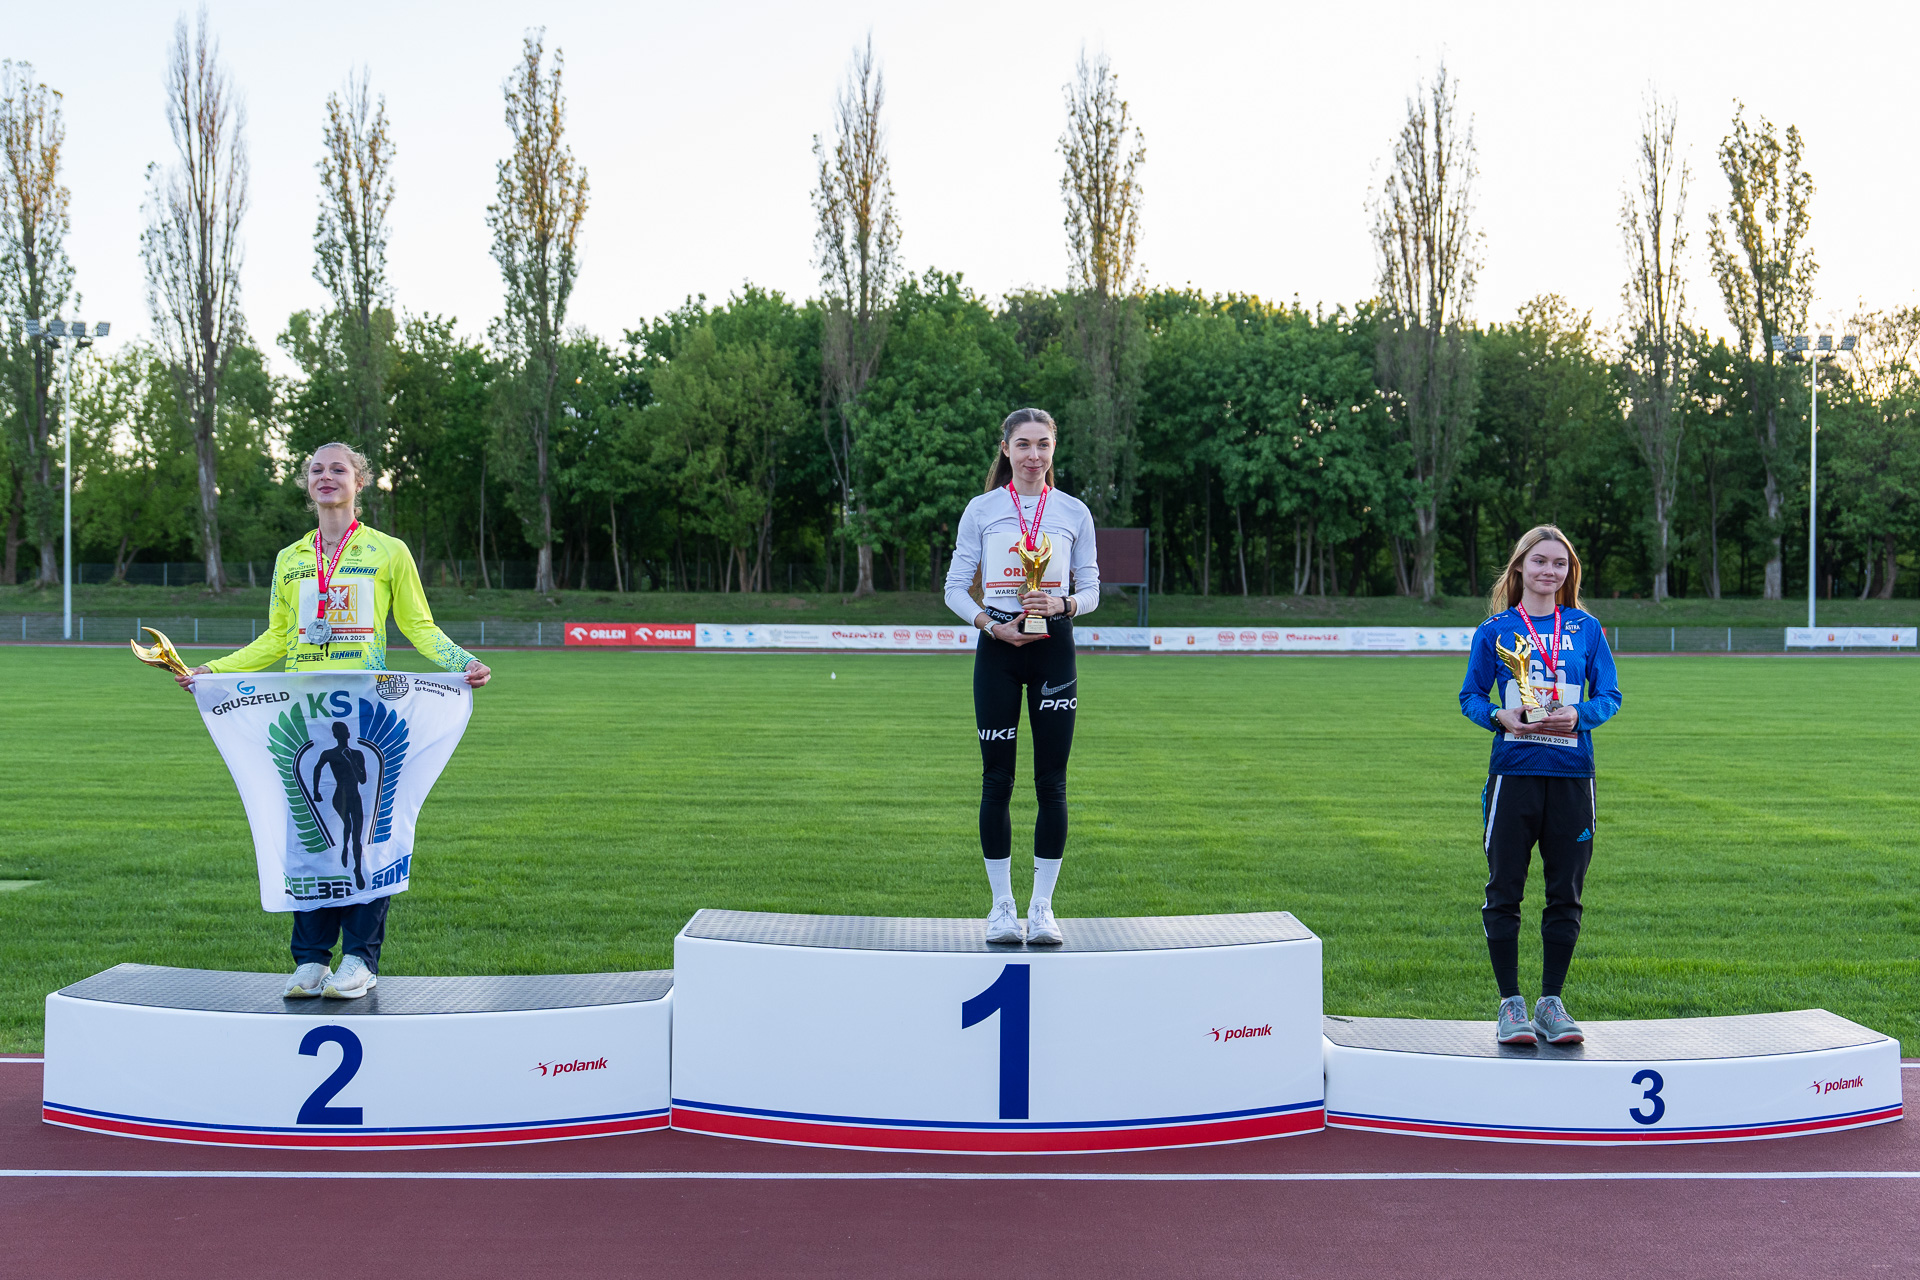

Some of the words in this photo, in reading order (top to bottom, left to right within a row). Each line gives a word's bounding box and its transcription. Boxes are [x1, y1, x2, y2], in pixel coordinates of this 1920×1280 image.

[991, 610, 1013, 621] PRO
[590, 629, 626, 639] ORLEN
[655, 630, 691, 640] ORLEN
[1523, 633, 1574, 651] STRA
[1529, 659, 1567, 685] 65
[413, 678, 461, 695] Zasmakuj
[212, 691, 290, 715] GRUSZFELD
[306, 690, 353, 719] KS
[1039, 697, 1077, 710] PRO
[977, 727, 1016, 741] NIKE
[1514, 734, 1552, 743] WARSZAWA
[371, 854, 412, 891] SON
[961, 963, 1031, 1120] 1
[1224, 1024, 1273, 1042] polanik
[295, 1024, 363, 1125] 2
[553, 1056, 608, 1077] polanik
[1824, 1075, 1864, 1095] polanik
[1629, 1069, 1666, 1125] 3
